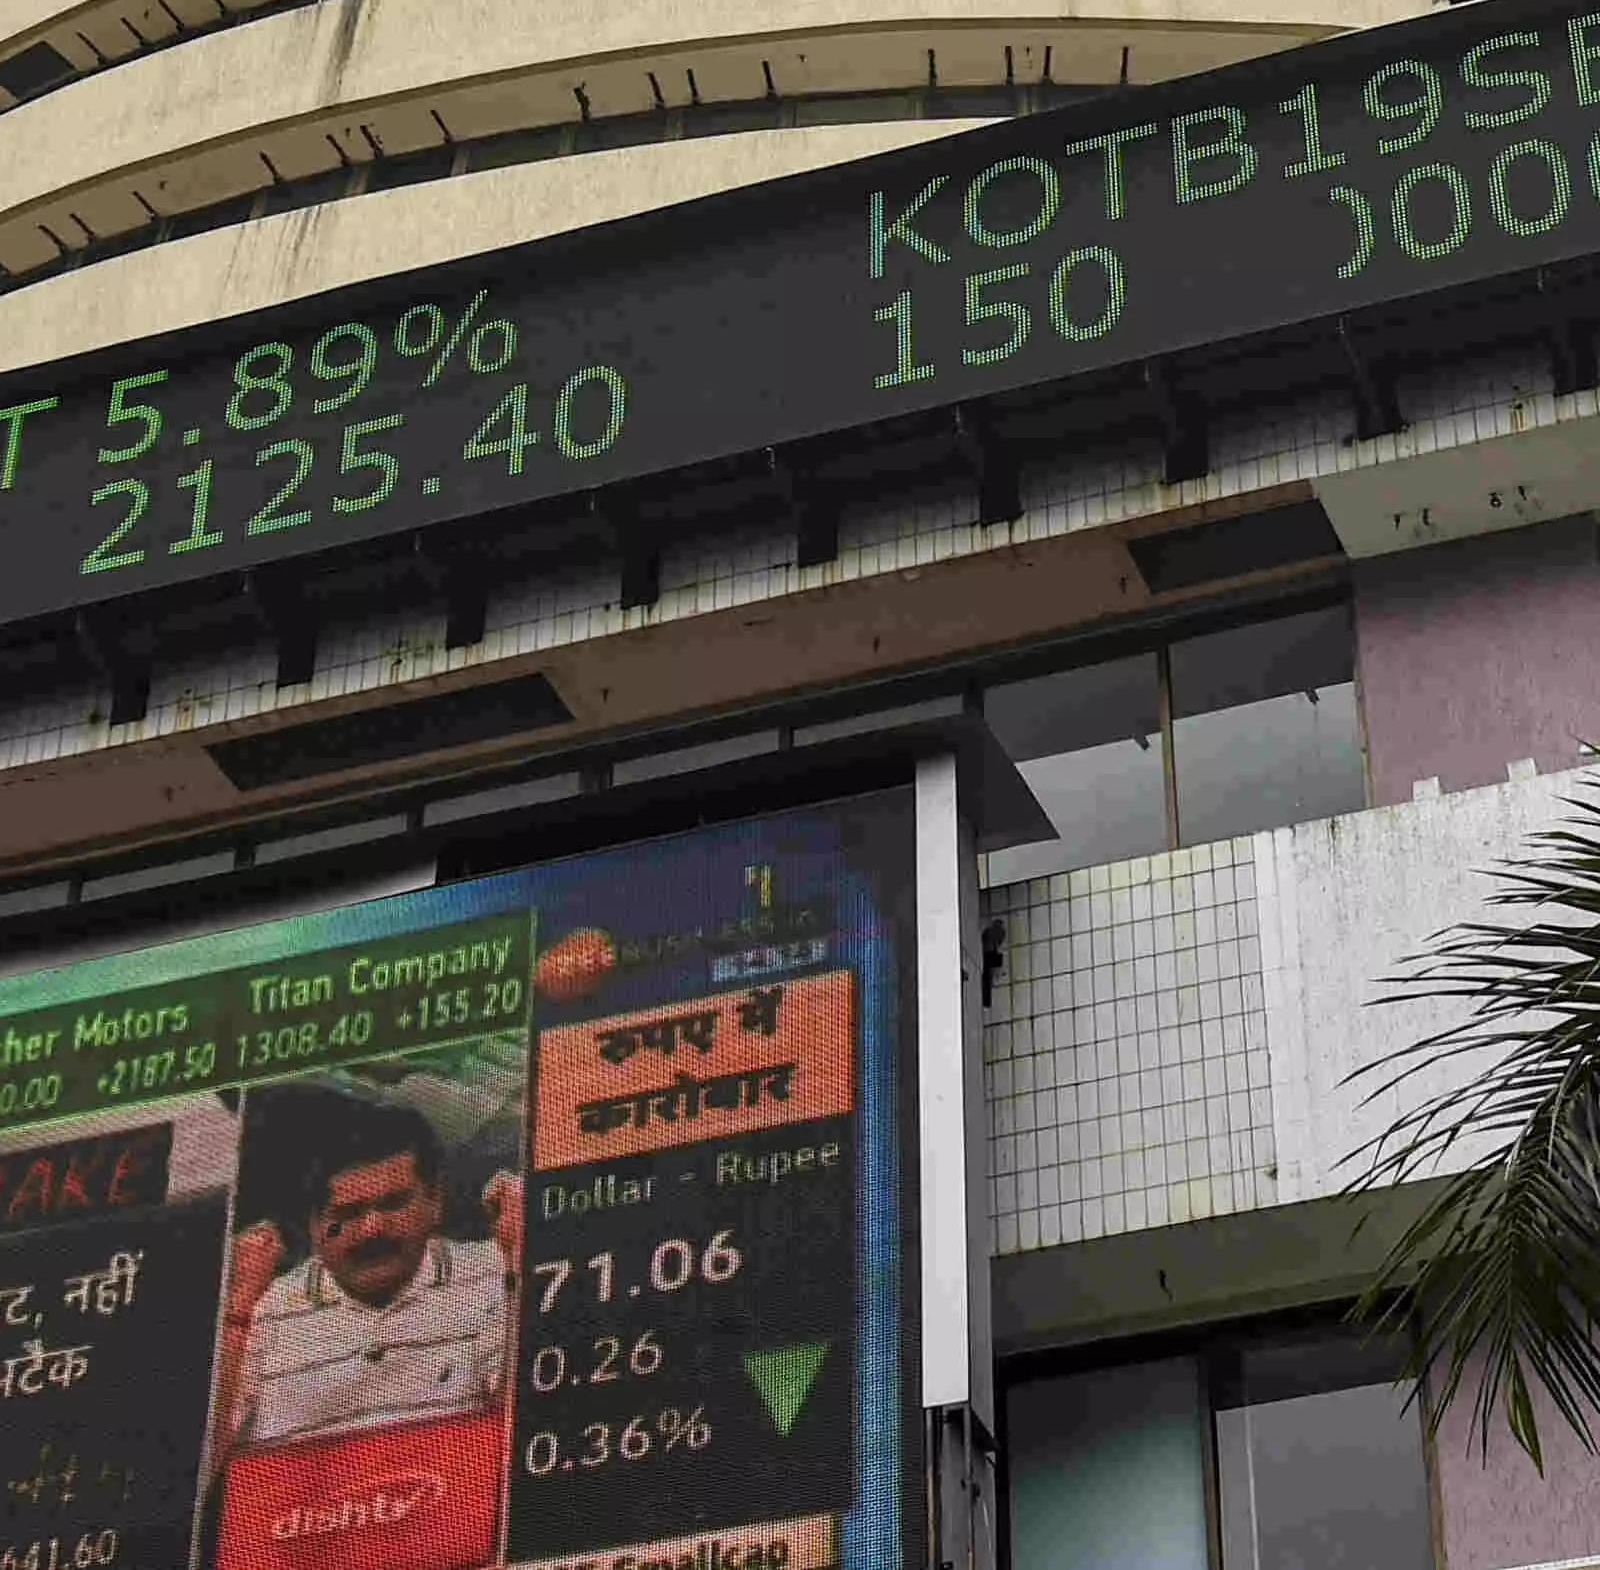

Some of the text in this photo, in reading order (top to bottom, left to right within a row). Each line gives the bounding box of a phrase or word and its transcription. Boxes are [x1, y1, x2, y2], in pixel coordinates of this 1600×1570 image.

[873, 245, 1128, 389] 150
[96, 288, 520, 464] 5.89%
[78, 365, 628, 575] 2125.40
[250, 974, 334, 1015] Titan
[348, 934, 513, 996] Company
[73, 1003, 190, 1051] Motors
[236, 1013, 374, 1072] 1308.40
[542, 1172, 657, 1223] Dollar
[715, 1138, 840, 1188] Rupee
[62, 1248, 146, 1316] नहीं
[534, 1229, 745, 1315] 71.06
[531, 1331, 666, 1393] 0.26
[525, 1404, 714, 1478] 0.36%
